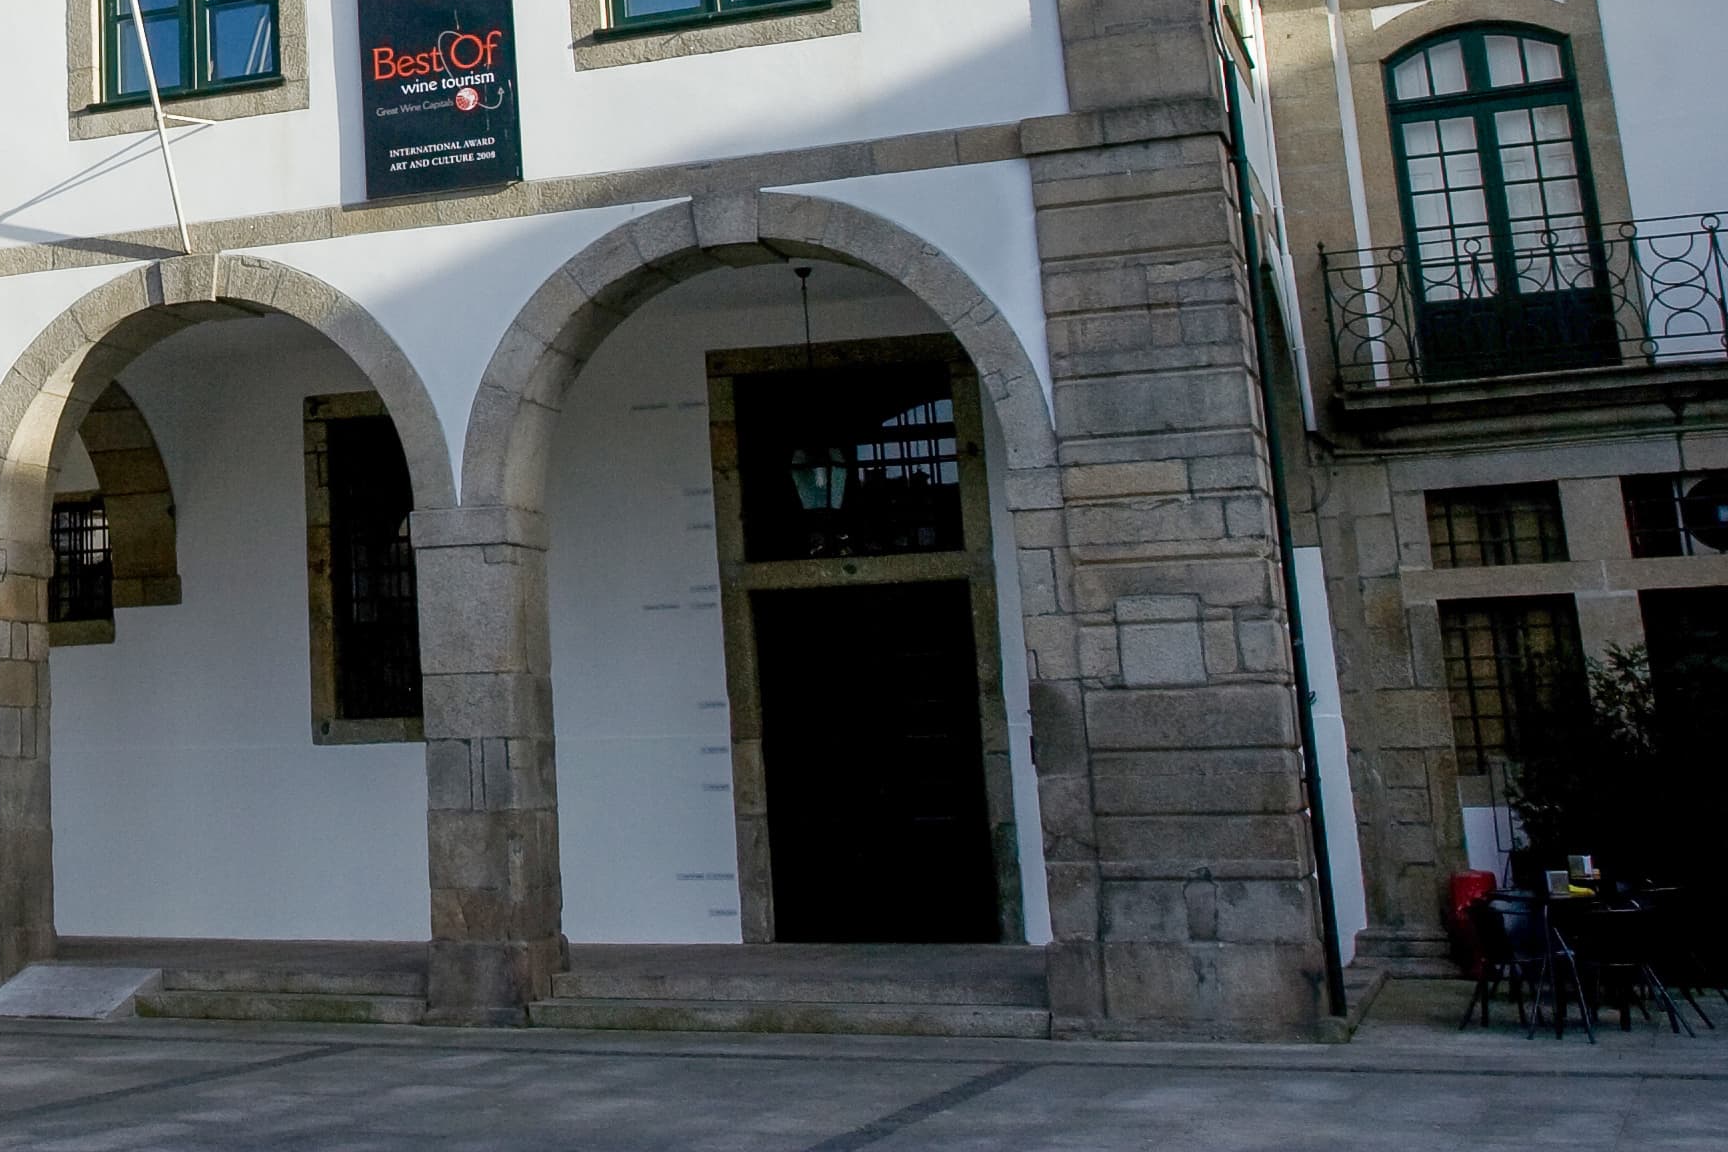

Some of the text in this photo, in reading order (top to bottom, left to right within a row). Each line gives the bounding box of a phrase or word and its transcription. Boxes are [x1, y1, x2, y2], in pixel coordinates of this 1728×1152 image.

[373, 30, 503, 80] Best Of
[401, 70, 495, 95] wine tourism
[375, 98, 454, 117] Great Wine Capitals
[389, 136, 496, 158] INTERNATIONAL AWARD
[389, 161, 408, 172] ART
[409, 159, 430, 169] AND
[431, 153, 475, 166] CULTURE
